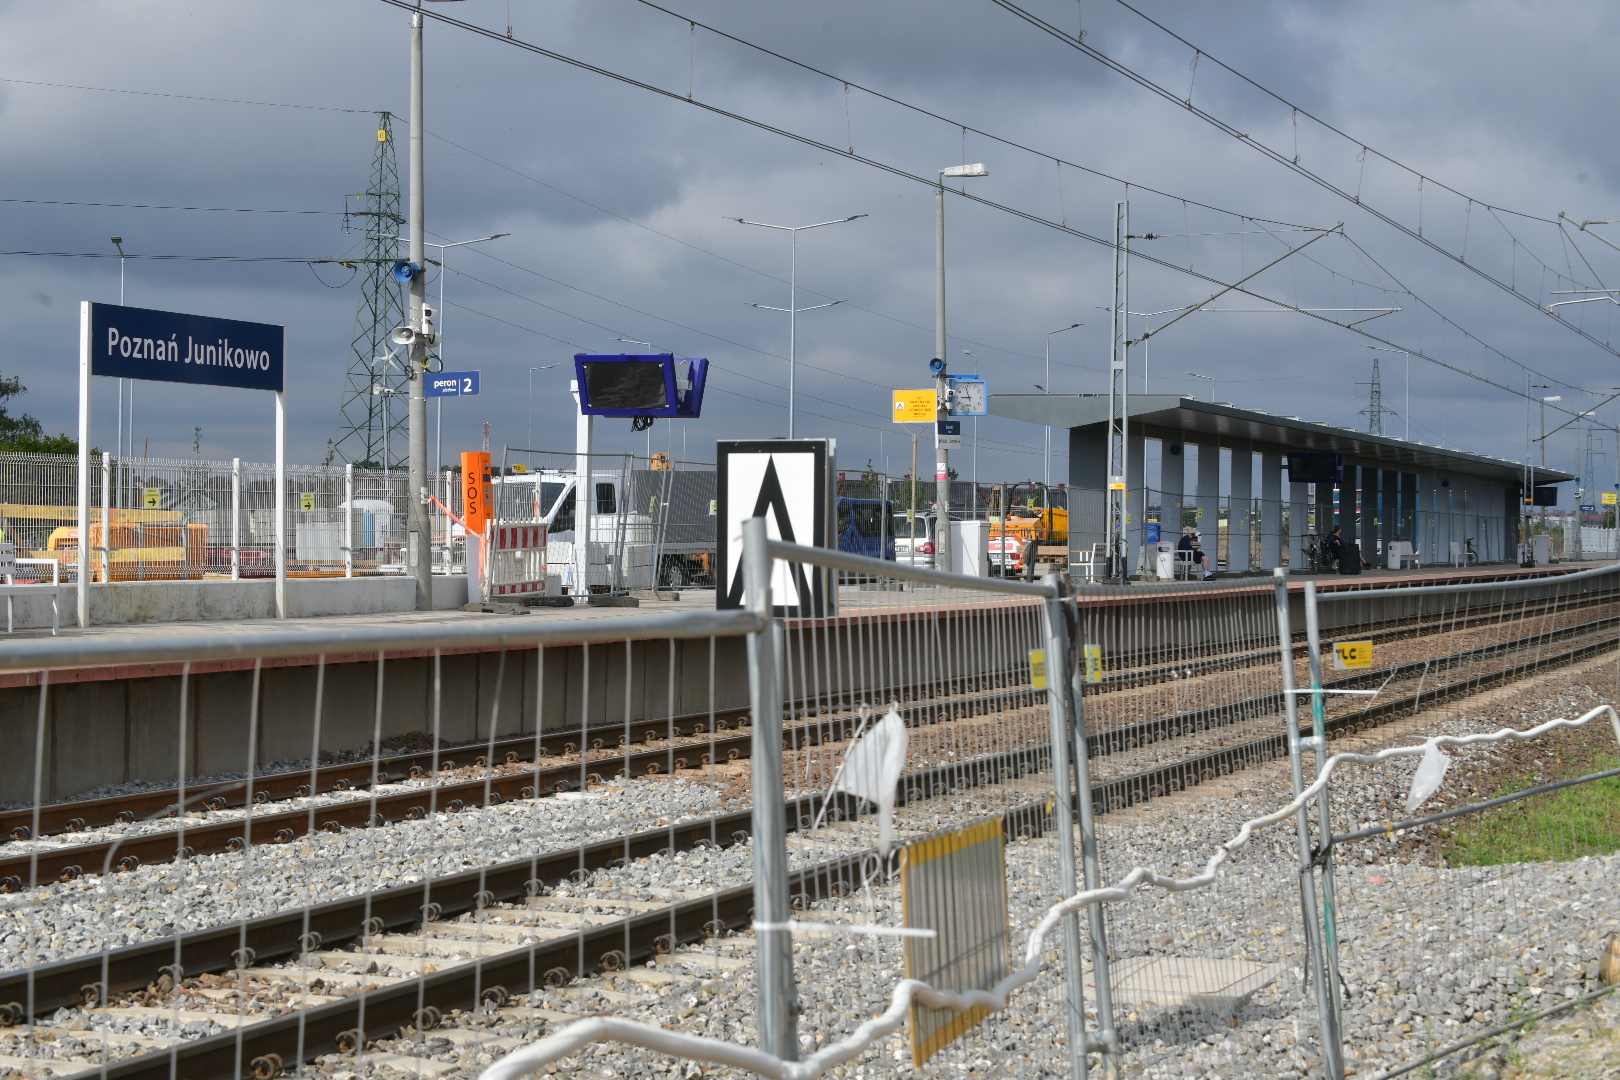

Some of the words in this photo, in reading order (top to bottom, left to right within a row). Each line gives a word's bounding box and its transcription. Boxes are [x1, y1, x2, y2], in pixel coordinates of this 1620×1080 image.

[108, 327, 178, 362] Poznań
[184, 335, 270, 371] Junikowo
[434, 380, 456, 389] peron
[463, 378, 473, 393] 2
[467, 471, 477, 515] SOS
[1335, 648, 1357, 661] TLC
